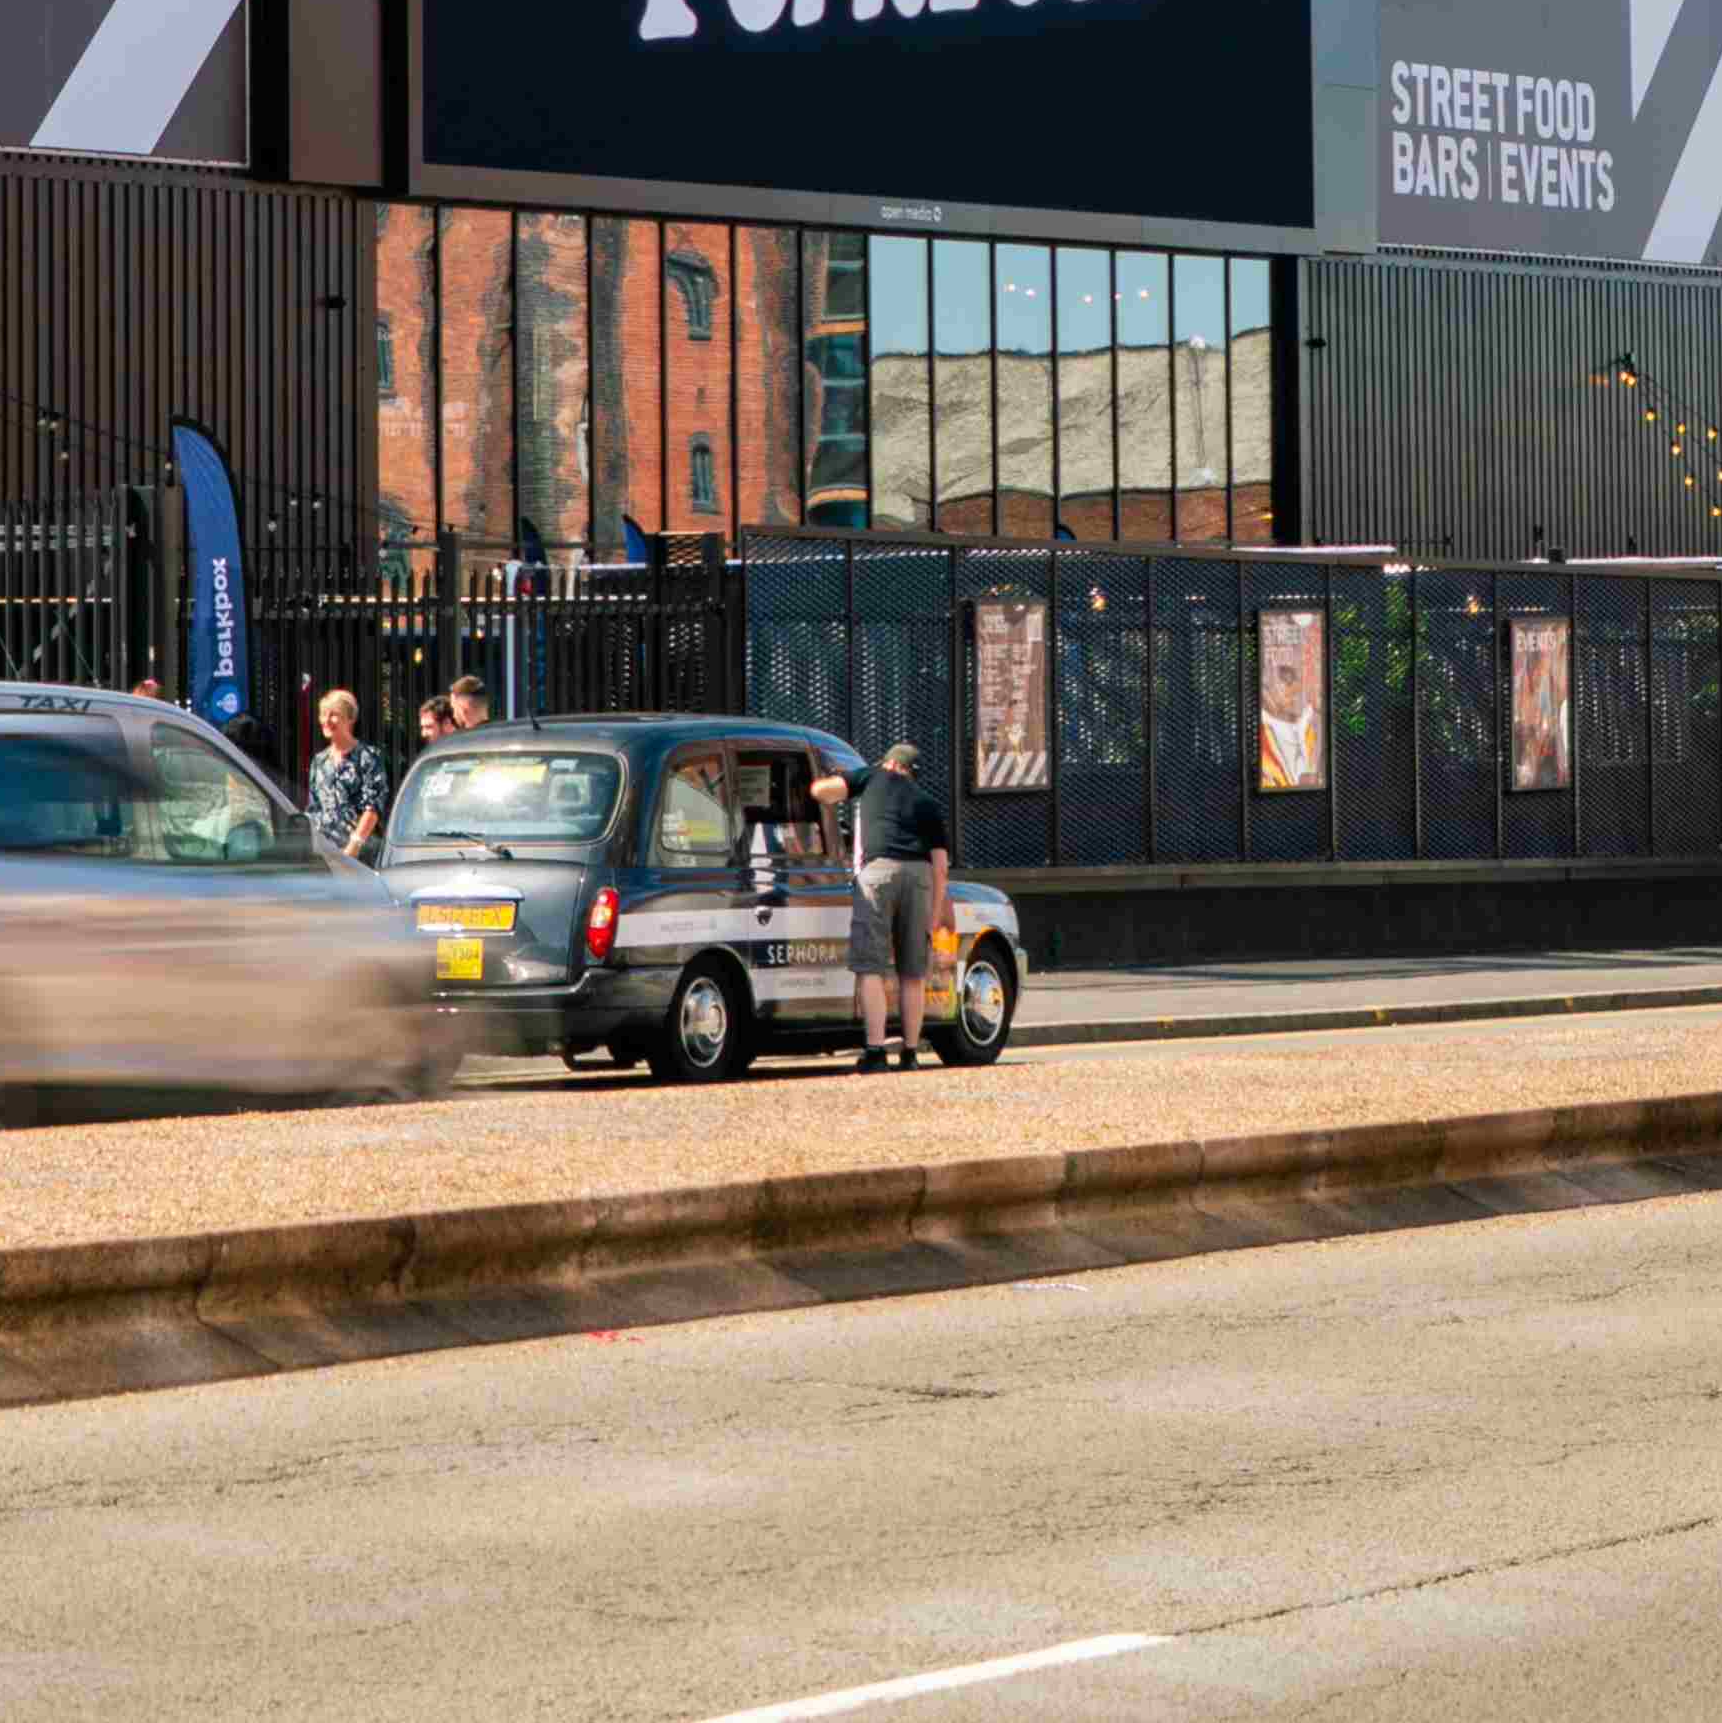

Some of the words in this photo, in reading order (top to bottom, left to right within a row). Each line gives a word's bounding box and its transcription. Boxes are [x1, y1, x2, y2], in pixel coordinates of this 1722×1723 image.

[1391, 59, 1510, 134] STREET
[1516, 75, 1596, 142] FOOD
[1392, 131, 1480, 201] BARS
[1500, 143, 1615, 212] EVENTS
[18, 694, 92, 712] TAXI
[765, 942, 839, 965] SEPHORA
